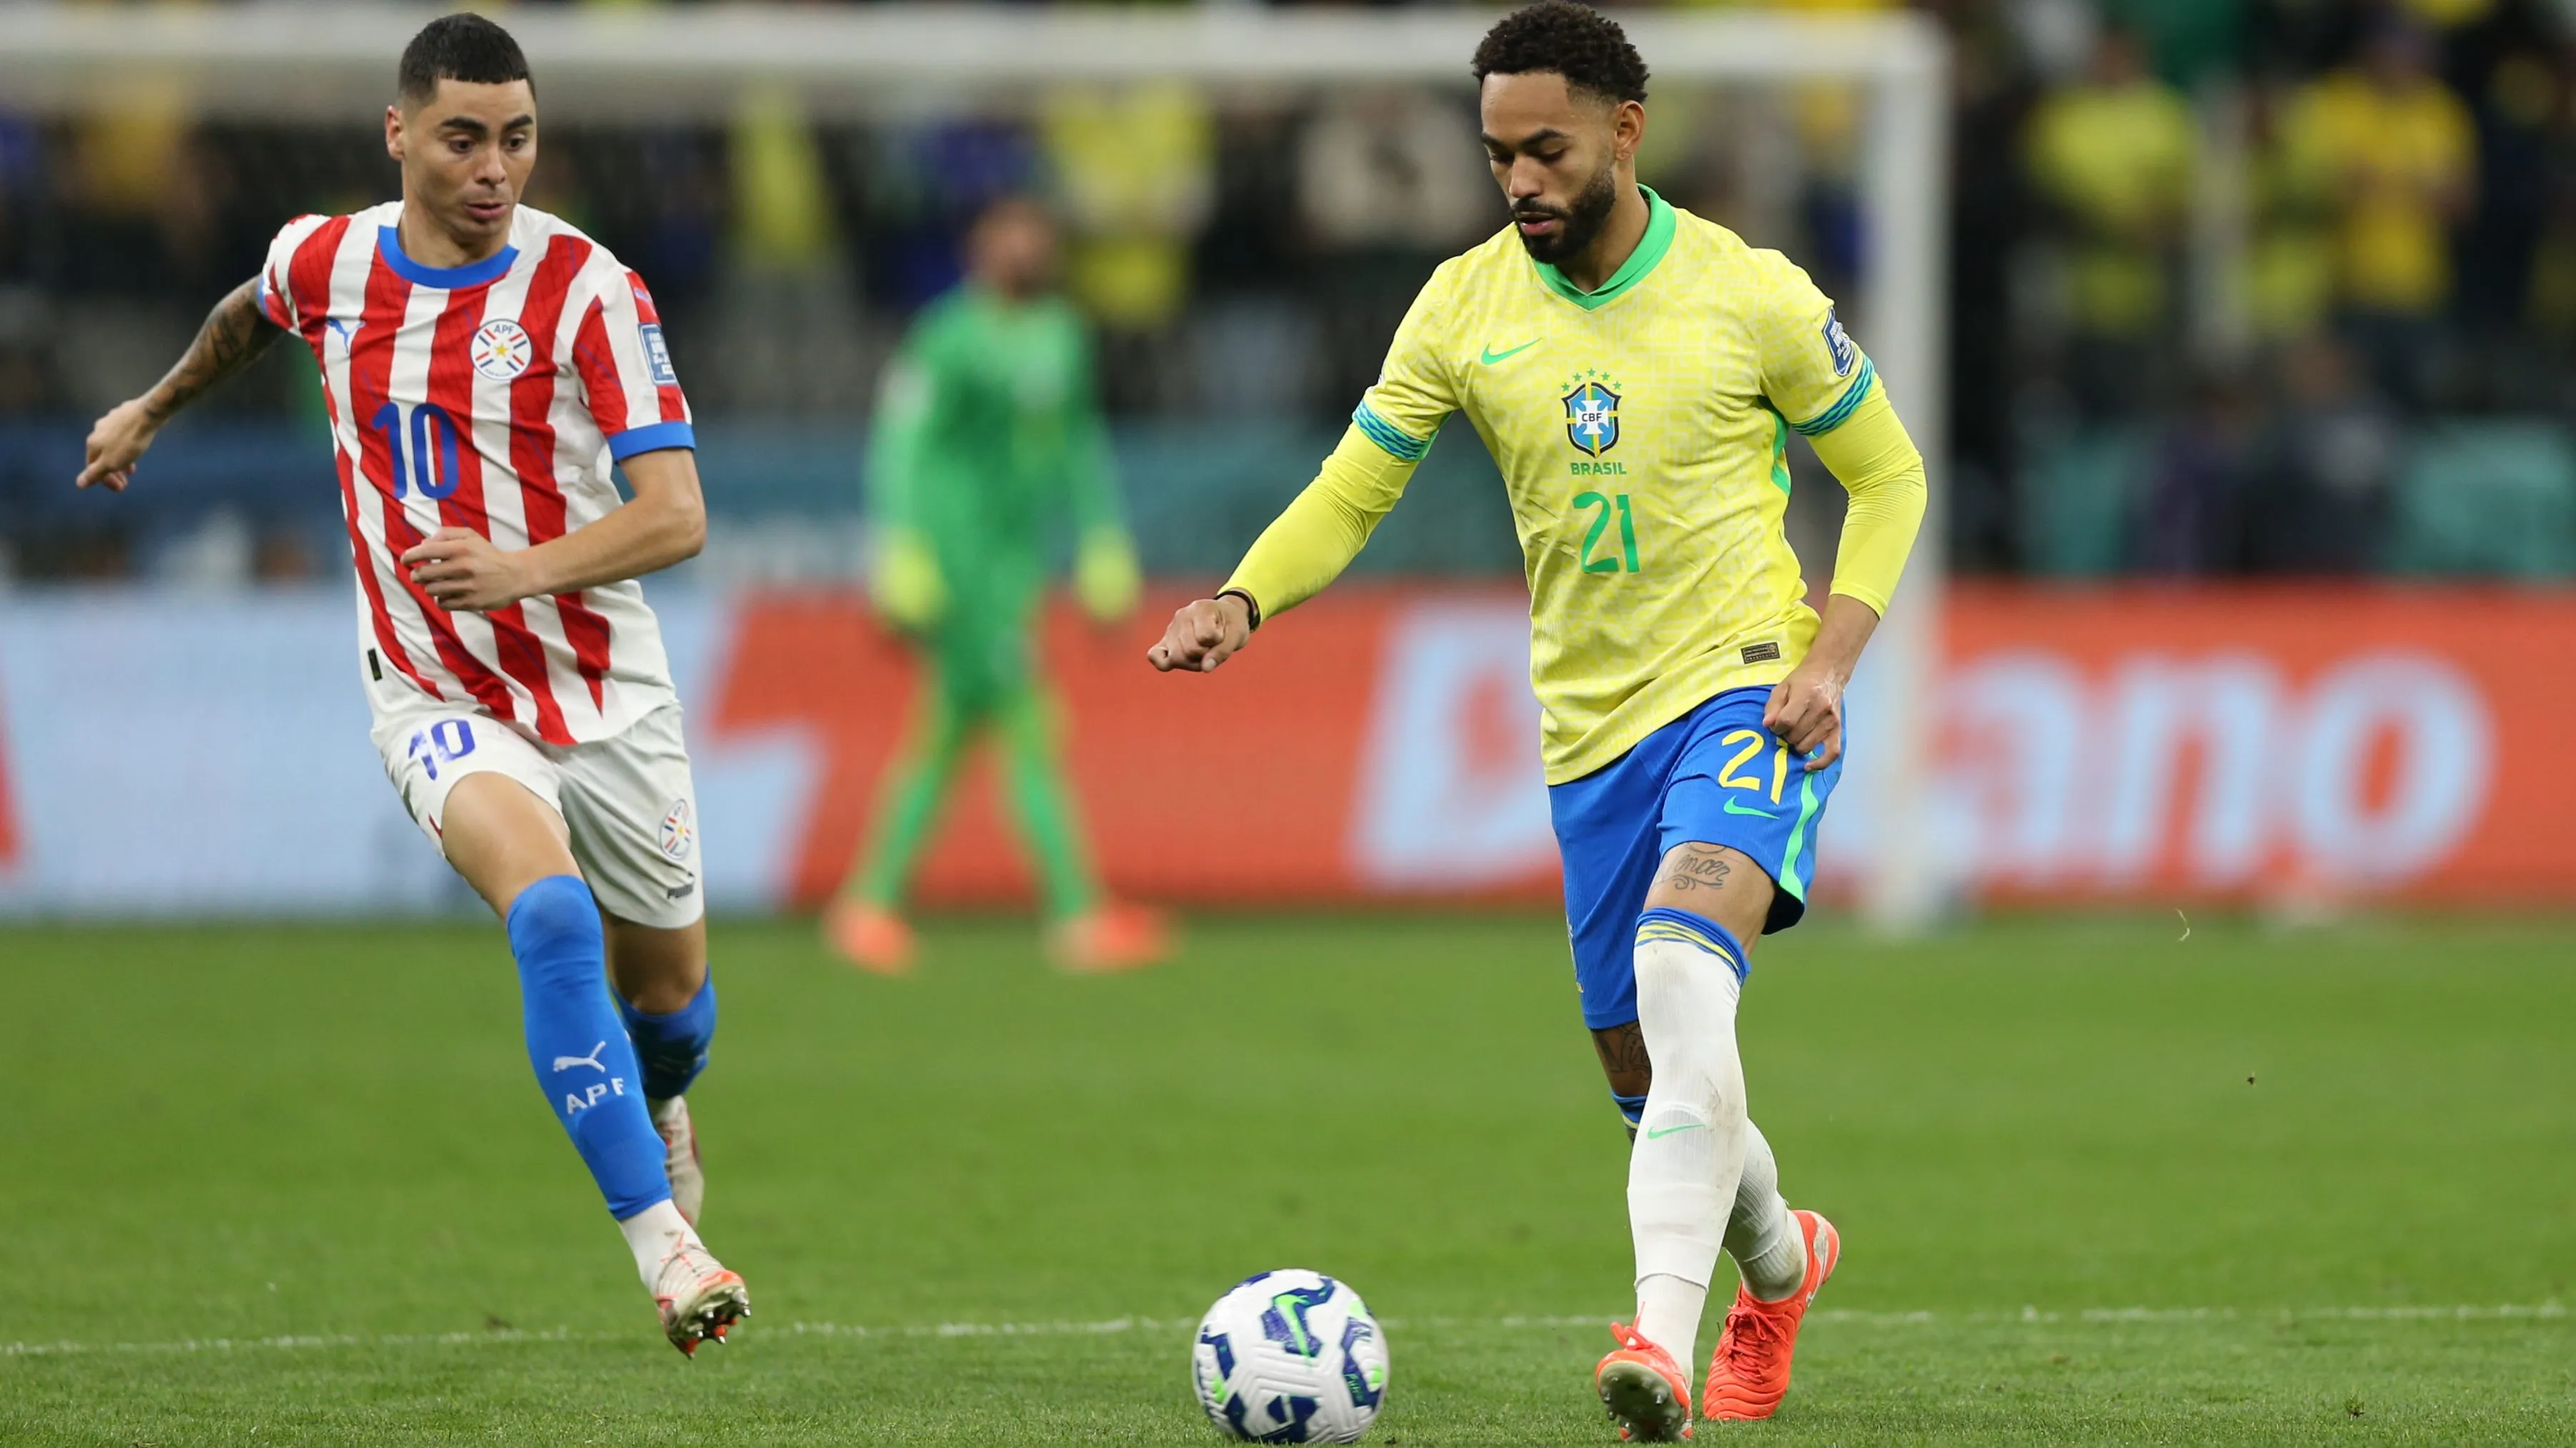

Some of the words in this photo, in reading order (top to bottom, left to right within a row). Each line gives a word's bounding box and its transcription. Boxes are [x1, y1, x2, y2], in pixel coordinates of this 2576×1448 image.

[494, 324, 514, 334] APF
[1581, 412, 1602, 422] CBF
[372, 402, 458, 499] 10
[1570, 462, 1627, 476] BRASIL
[1572, 491, 1640, 573] 21
[408, 718, 476, 780] 10
[1718, 729, 1788, 806] 21
[566, 1077, 624, 1115] APF
